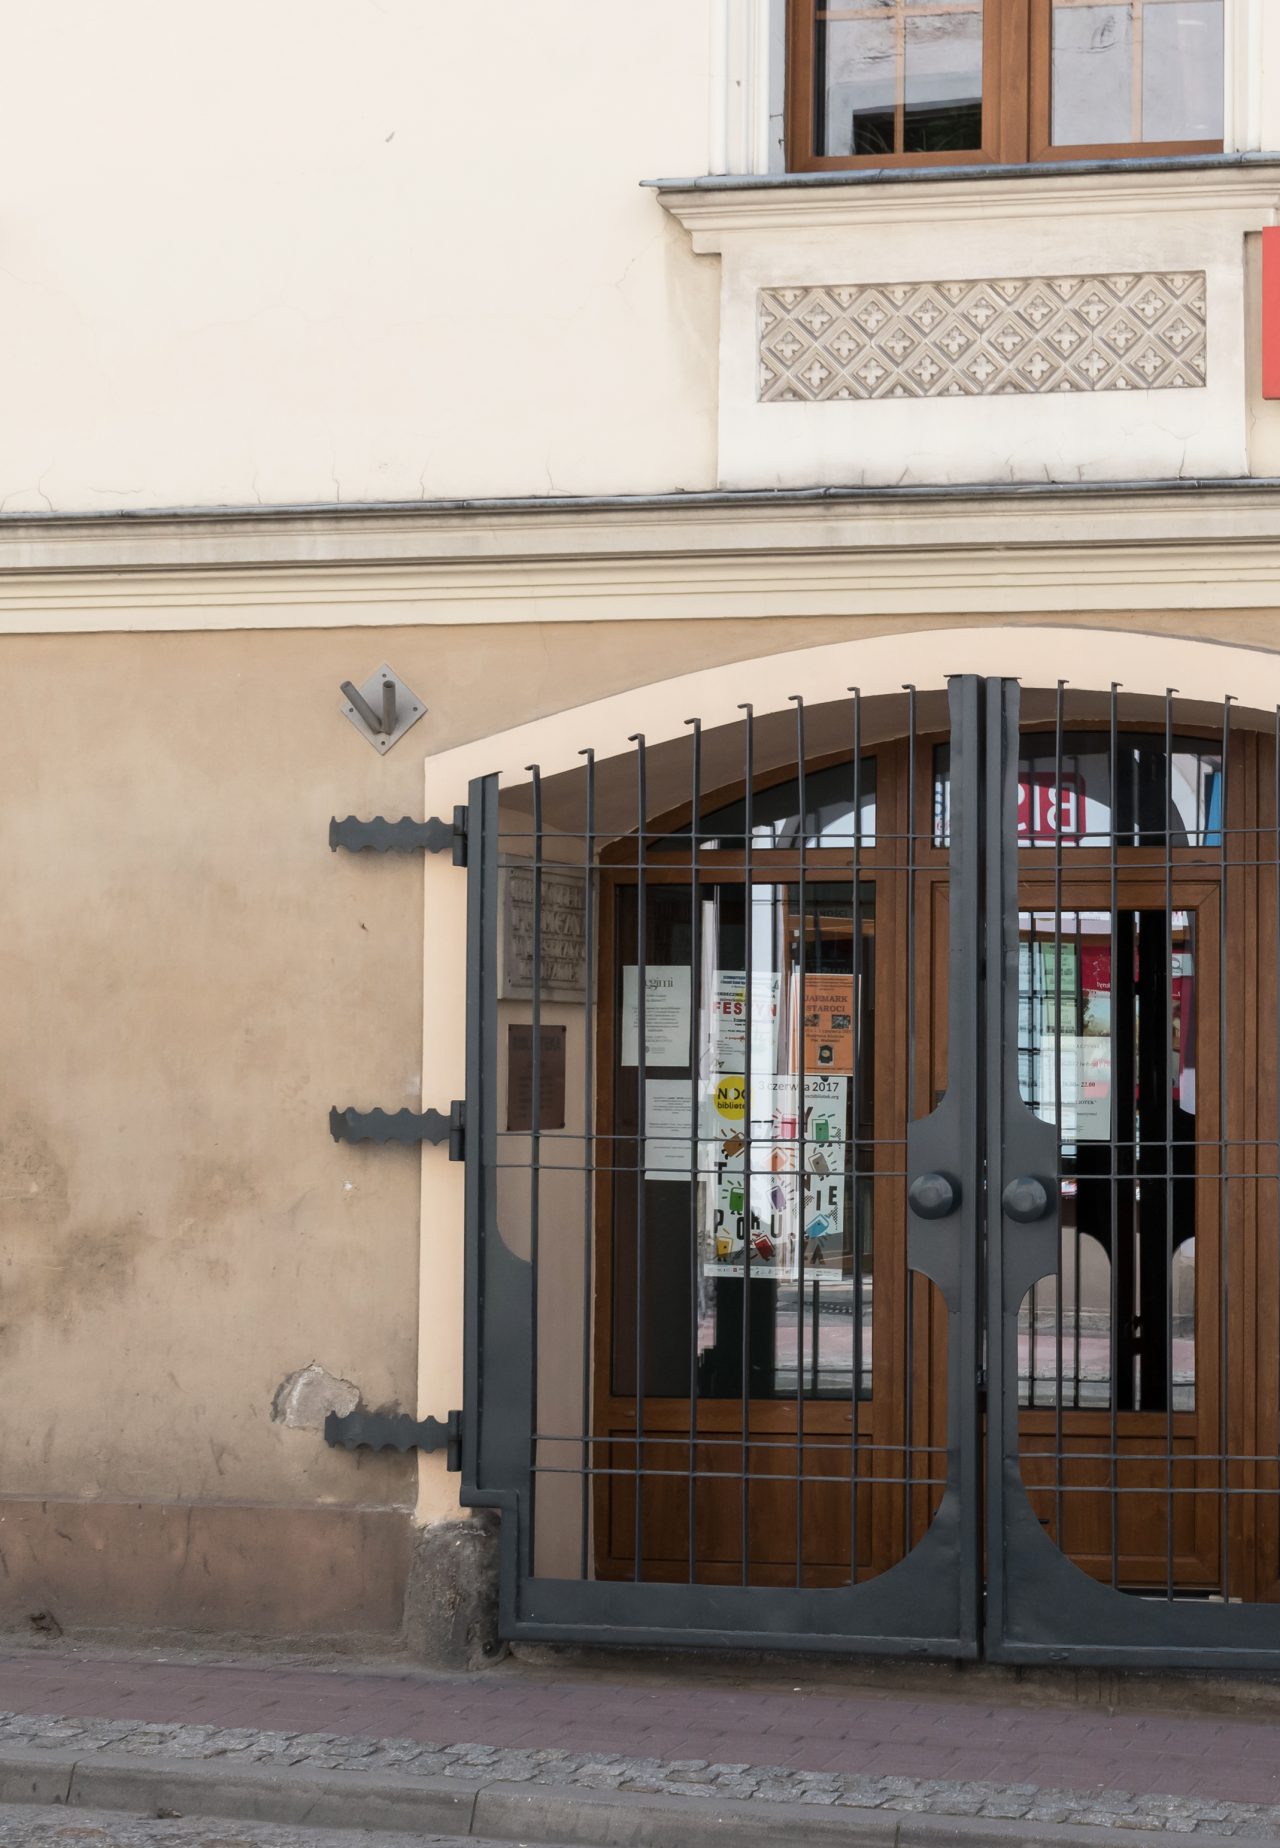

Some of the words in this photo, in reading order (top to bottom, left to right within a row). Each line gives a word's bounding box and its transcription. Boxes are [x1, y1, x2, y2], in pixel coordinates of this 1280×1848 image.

[806, 1004, 845, 1013] STAROCI
[767, 1082, 810, 1092] czerwa
[812, 1081, 840, 1092] 2017
